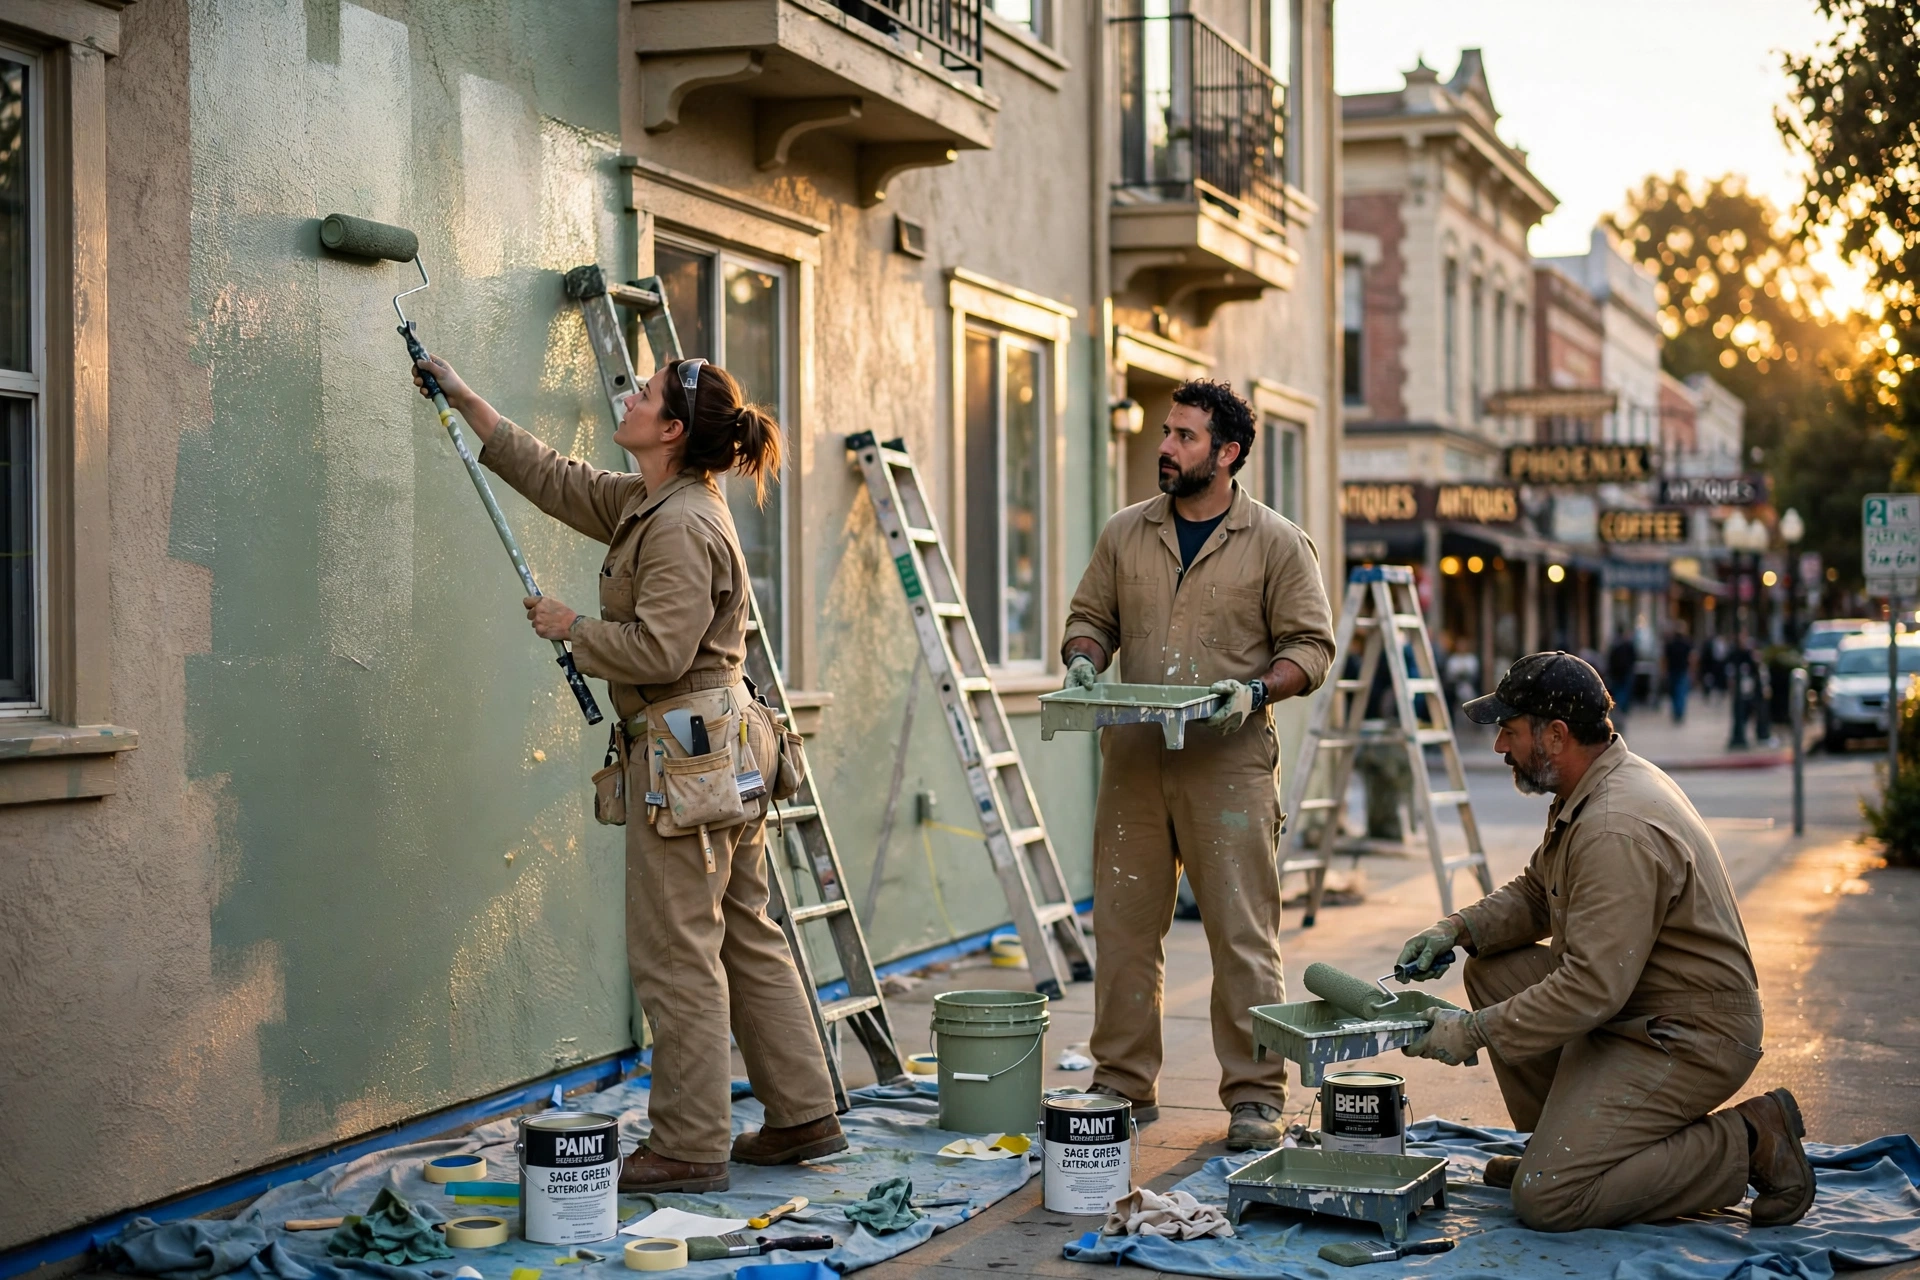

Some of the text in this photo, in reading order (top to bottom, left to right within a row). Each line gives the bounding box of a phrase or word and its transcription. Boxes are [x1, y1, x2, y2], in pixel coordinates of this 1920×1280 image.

[1510, 447, 1643, 480] PHOENIX
[1870, 500, 1882, 526] 2
[1601, 511, 1682, 542] COFFEE
[1335, 1093, 1379, 1113] BEHR
[1069, 1117, 1115, 1135] PAINT
[555, 1134, 605, 1156] PAINT
[1064, 1146, 1121, 1159] SAGE GREEN
[1062, 1159, 1099, 1169] EXTERIOR
[549, 1166, 611, 1183] SAGE GREEN
[547, 1184, 589, 1194] EXTERIOR
